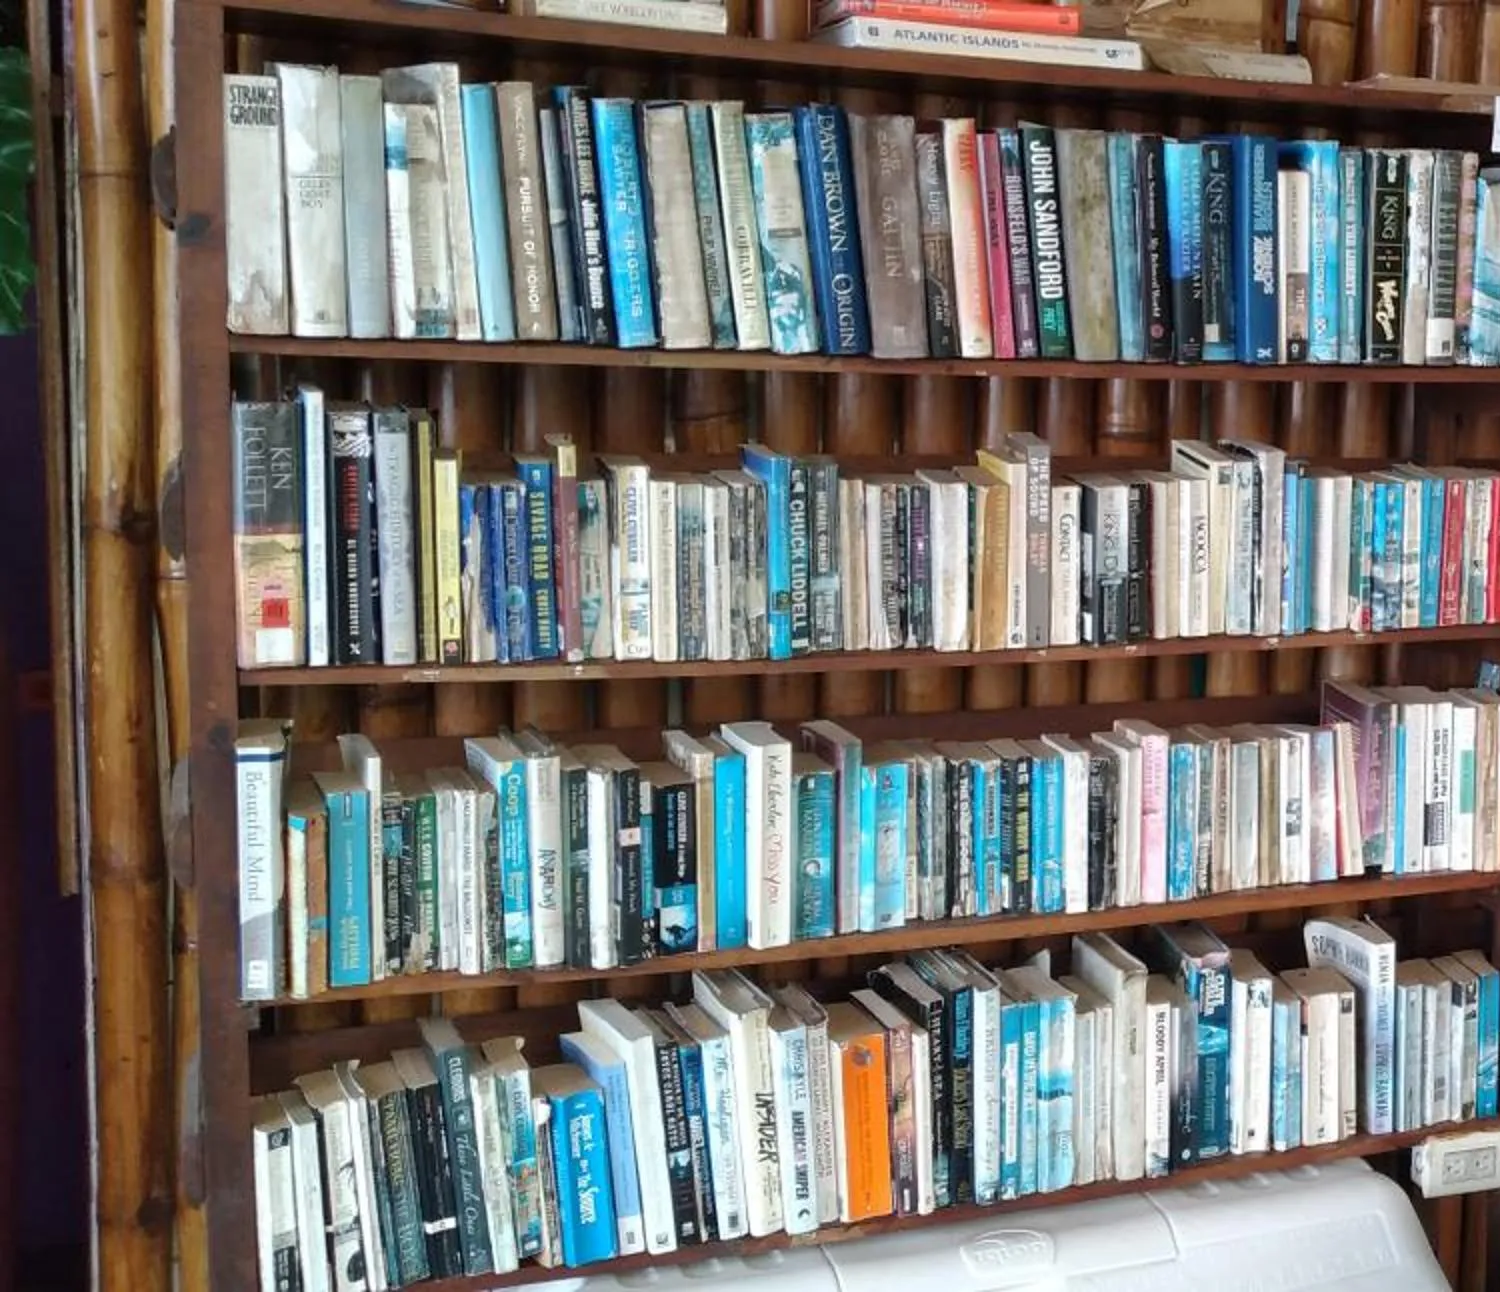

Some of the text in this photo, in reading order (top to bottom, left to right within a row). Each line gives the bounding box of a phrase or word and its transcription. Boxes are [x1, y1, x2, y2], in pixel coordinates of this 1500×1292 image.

[893, 28, 1019, 50] ATLANTIC ISLANDS
[229, 83, 279, 103] STRANGE
[576, 138, 589, 158] LEE
[926, 143, 941, 185] Heavy
[816, 114, 848, 253] DAN BROWN
[1205, 172, 1227, 224] KING
[1005, 175, 1028, 256] RUMSFELD'S
[1029, 140, 1064, 300] JOHN SANDFORD
[1380, 194, 1399, 240] KING
[519, 177, 541, 314] PURSUIT OF HONOR
[624, 230, 642, 318] TRIGGERS
[831, 273, 857, 348] ORIGIN
[243, 427, 267, 513] FOLLETT
[270, 446, 293, 490] KEN
[1029, 456, 1040, 474] OF
[1039, 456, 1050, 481] THE
[528, 490, 550, 580] SAVAGE ROAD
[817, 533, 829, 573] PALMER
[1058, 513, 1076, 564] CONTACT
[1103, 512, 1116, 550] KING
[789, 499, 809, 632] CHUCK LIDDELL
[767, 754, 783, 780] Kate
[506, 773, 522, 816] Coop
[246, 771, 266, 902] Beautiful Mind
[767, 833, 784, 871] Miss
[538, 848, 558, 912] ANARCHY
[1155, 1011, 1166, 1053] BLOODY
[792, 1038, 807, 1074] CHRIS
[1154, 1055, 1166, 1086] APRIL
[754, 1091, 781, 1164] INSIDER
[791, 1110, 810, 1201] AMERICAN SNIPER
[464, 1206, 482, 1237] Ones
